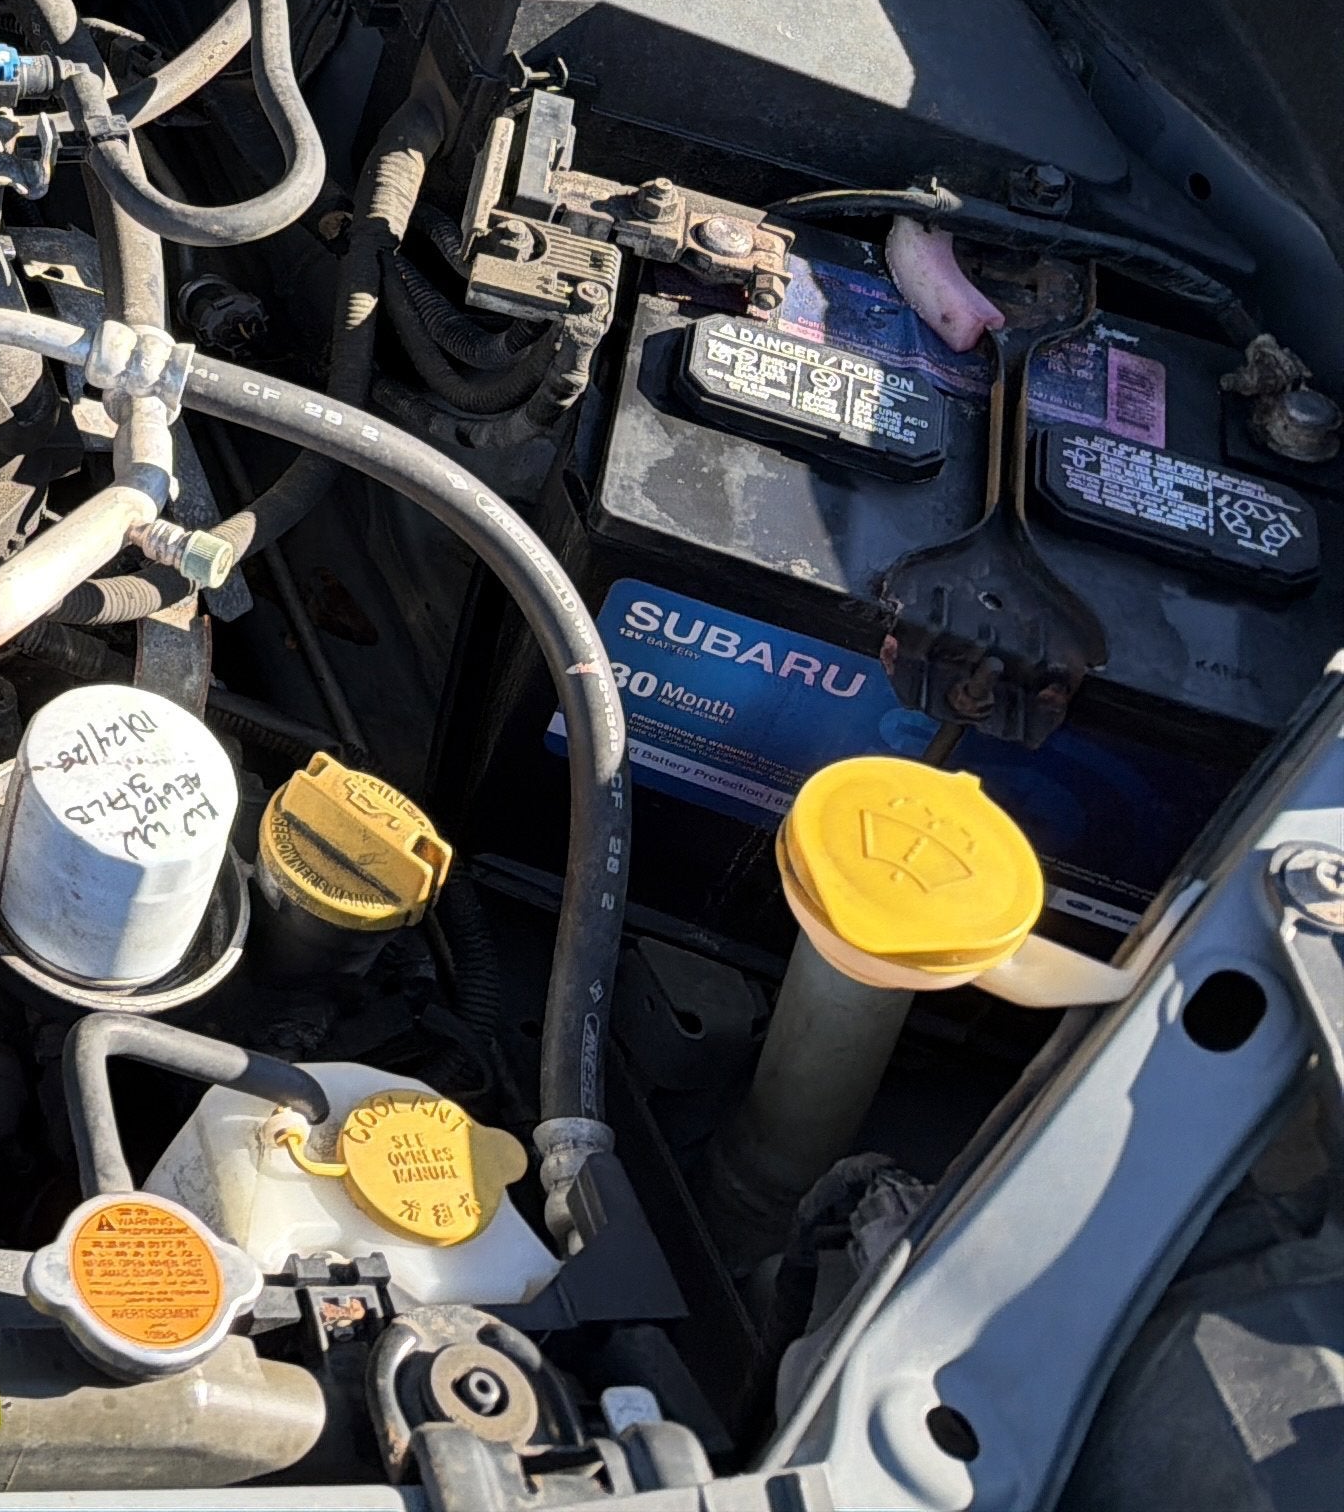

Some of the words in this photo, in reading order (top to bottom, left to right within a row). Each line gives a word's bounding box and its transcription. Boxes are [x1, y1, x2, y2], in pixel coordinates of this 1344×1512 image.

[740, 328, 820, 363] DANGER
[841, 359, 914, 392] POISON
[242, 381, 281, 401] CF
[361, 425, 381, 442] 2
[903, 414, 929, 429] ACID
[618, 627, 643, 641] 12V
[647, 637, 702, 661] BATTERY
[625, 600, 867, 698] SUBARU
[610, 662, 658, 698] 30
[660, 680, 736, 720] Month
[630, 711, 694, 739] PROPOSITION
[640, 748, 691, 774] Battery
[693, 767, 765, 800] Protection
[271, 815, 286, 842] SEE
[329, 884, 390, 907] MANUAL
[1095, 909, 1139, 925] SUBAR
[344, 1094, 473, 1146] COOLANT
[390, 1133, 425, 1150] SEE
[392, 1164, 458, 1184] MANUAL
[117, 1217, 173, 1226] WARNING
[111, 1307, 199, 1320] AVERTISSEMENT
